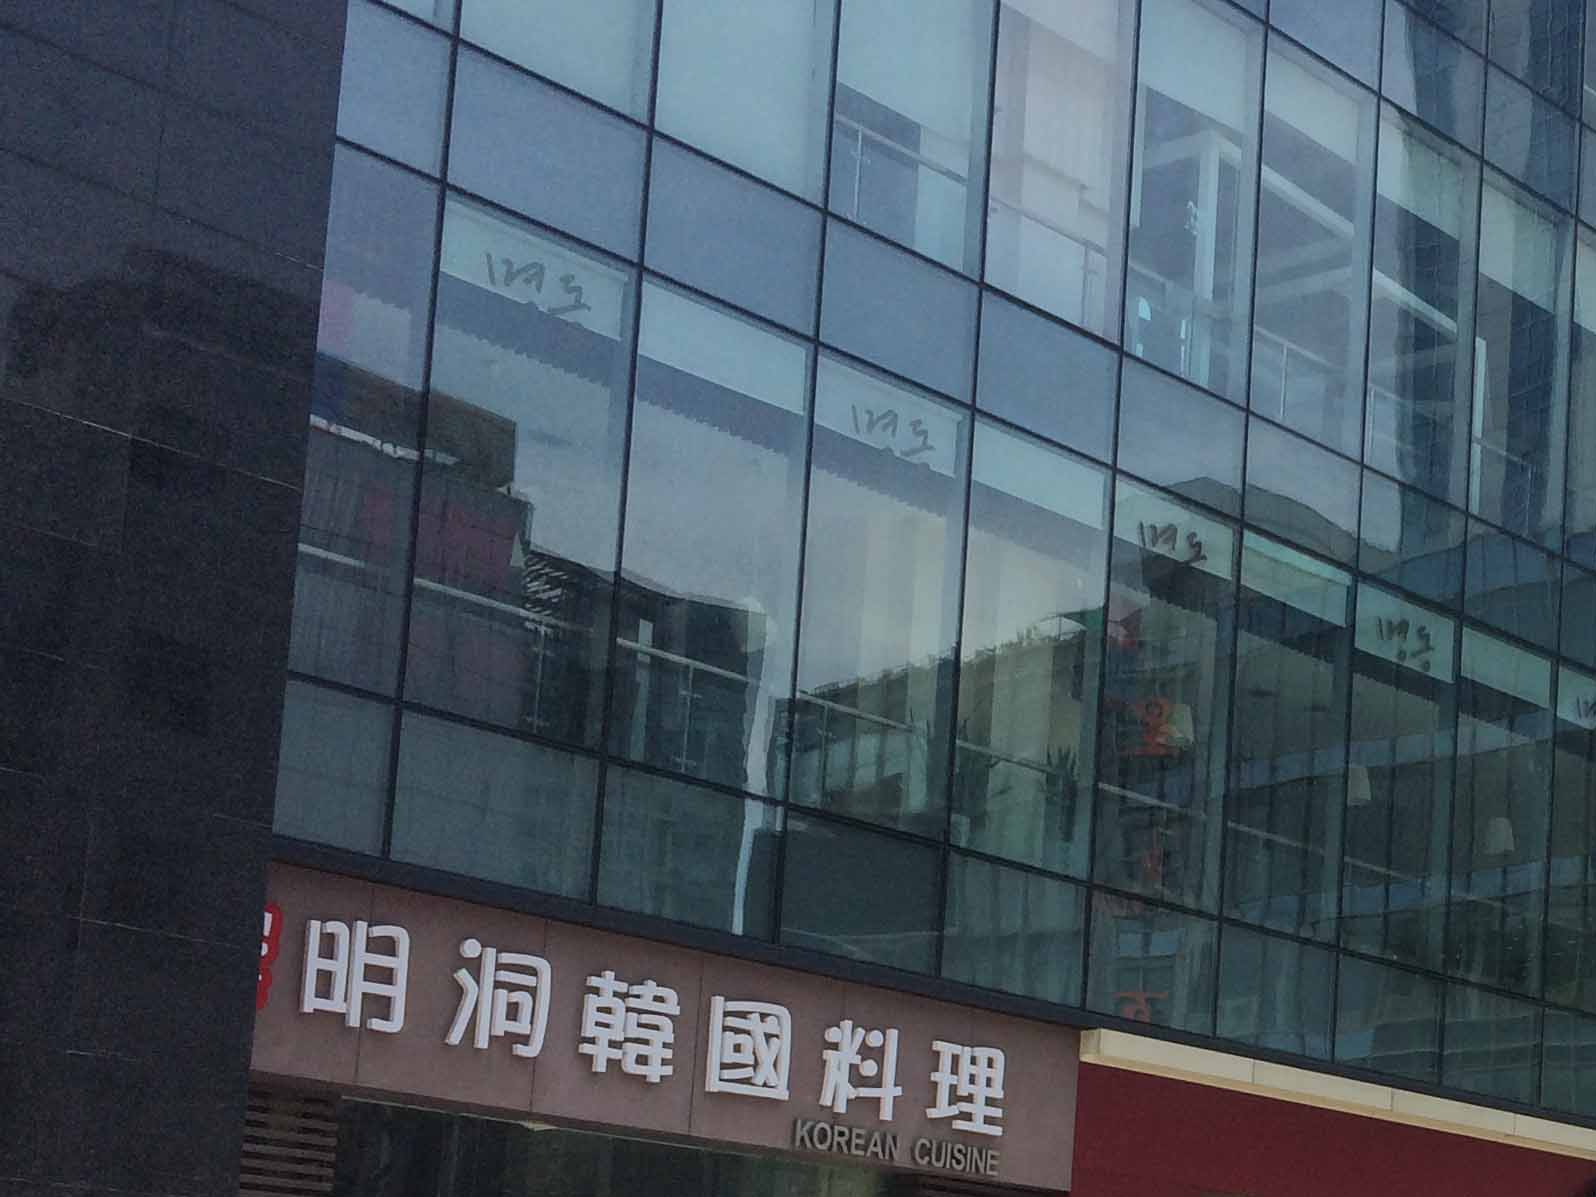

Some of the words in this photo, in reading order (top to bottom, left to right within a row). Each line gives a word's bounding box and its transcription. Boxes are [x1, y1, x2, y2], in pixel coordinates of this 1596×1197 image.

[299, 918, 1006, 1137] 明洞韓國料理
[795, 1119, 900, 1161] KOREAN
[914, 1138, 1001, 1176] CUISINE
